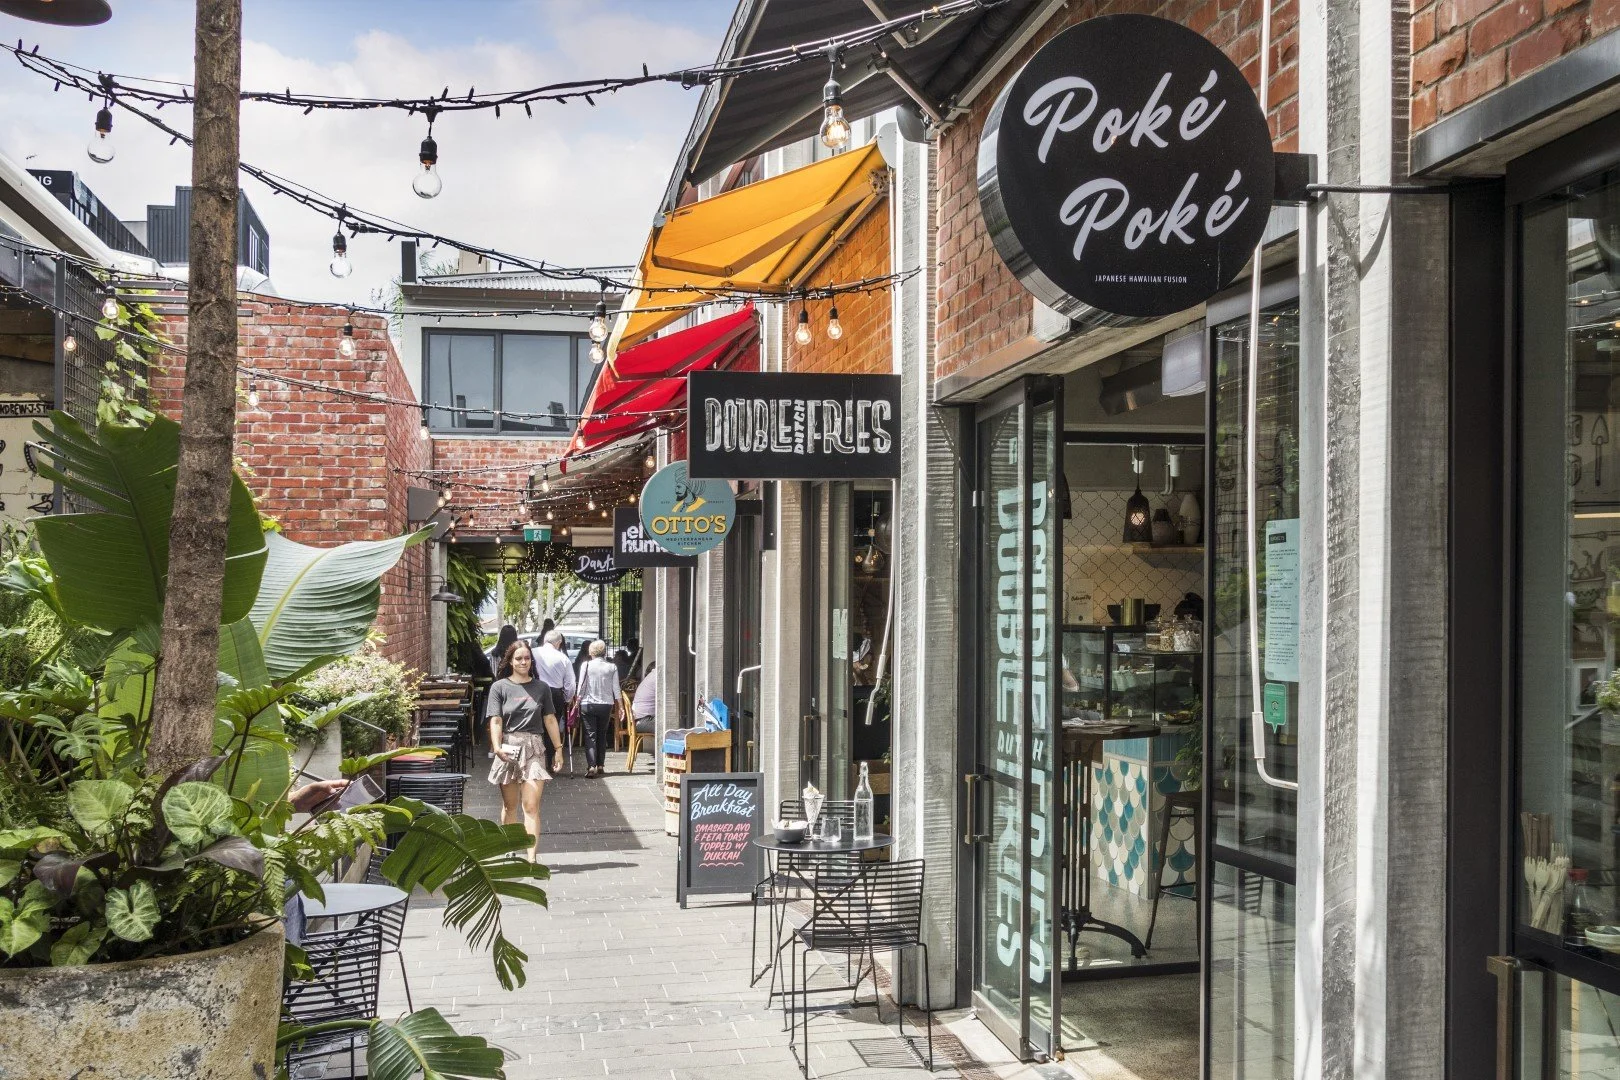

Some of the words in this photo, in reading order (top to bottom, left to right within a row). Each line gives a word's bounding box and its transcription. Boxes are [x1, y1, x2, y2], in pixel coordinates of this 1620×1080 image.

[1023, 69, 1226, 163] Poké
[1059, 169, 1249, 261] Poké
[1129, 275, 1162, 283] HAWAIIAN
[1163, 275, 1187, 284] FUSION
[704, 397, 793, 453] DOUBLE
[793, 399, 805, 455] DUTCH
[806, 398, 891, 454] FRIES
[651, 515, 727, 535] OTTO'S
[621, 531, 669, 553] hum
[574, 553, 616, 573] Dant
[997, 729, 1044, 762] DUTH
[691, 783, 723, 804] All
[724, 783, 753, 805] Day
[691, 798, 756, 821] Breakfast
[694, 823, 734, 832] SMASHED
[734, 823, 751, 832] AVO
[700, 832, 721, 841] FETA
[724, 832, 750, 841] TOAST
[699, 842, 732, 851] TOPPED
[703, 851, 741, 860] DUKKAH
